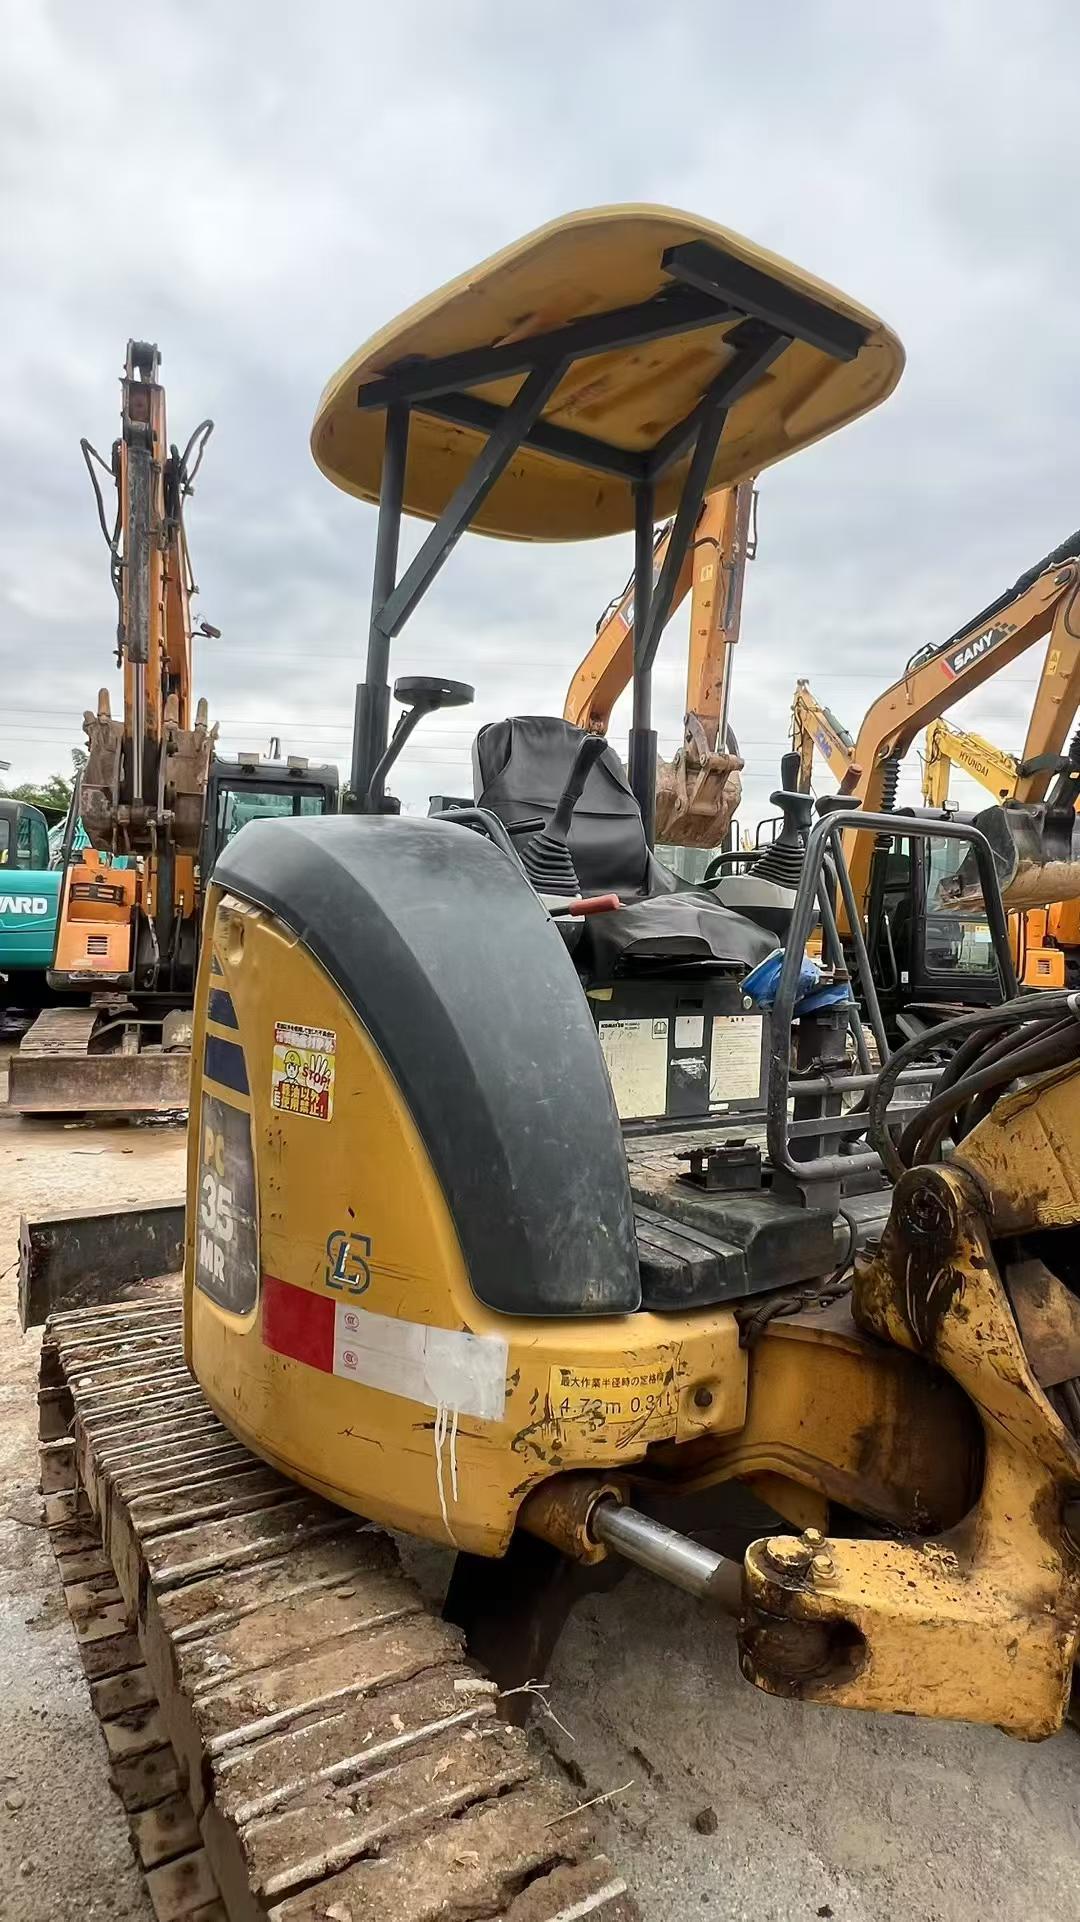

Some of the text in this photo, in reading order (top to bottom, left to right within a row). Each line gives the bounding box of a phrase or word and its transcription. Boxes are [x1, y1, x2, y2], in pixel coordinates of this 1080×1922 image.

[953, 629, 994, 671] SANY
[958, 750, 989, 777] HYUNDAI
[0, 896, 48, 914] ARD
[204, 1126, 226, 1178] PC
[201, 1174, 235, 1242] 35
[198, 1234, 226, 1284] MR
